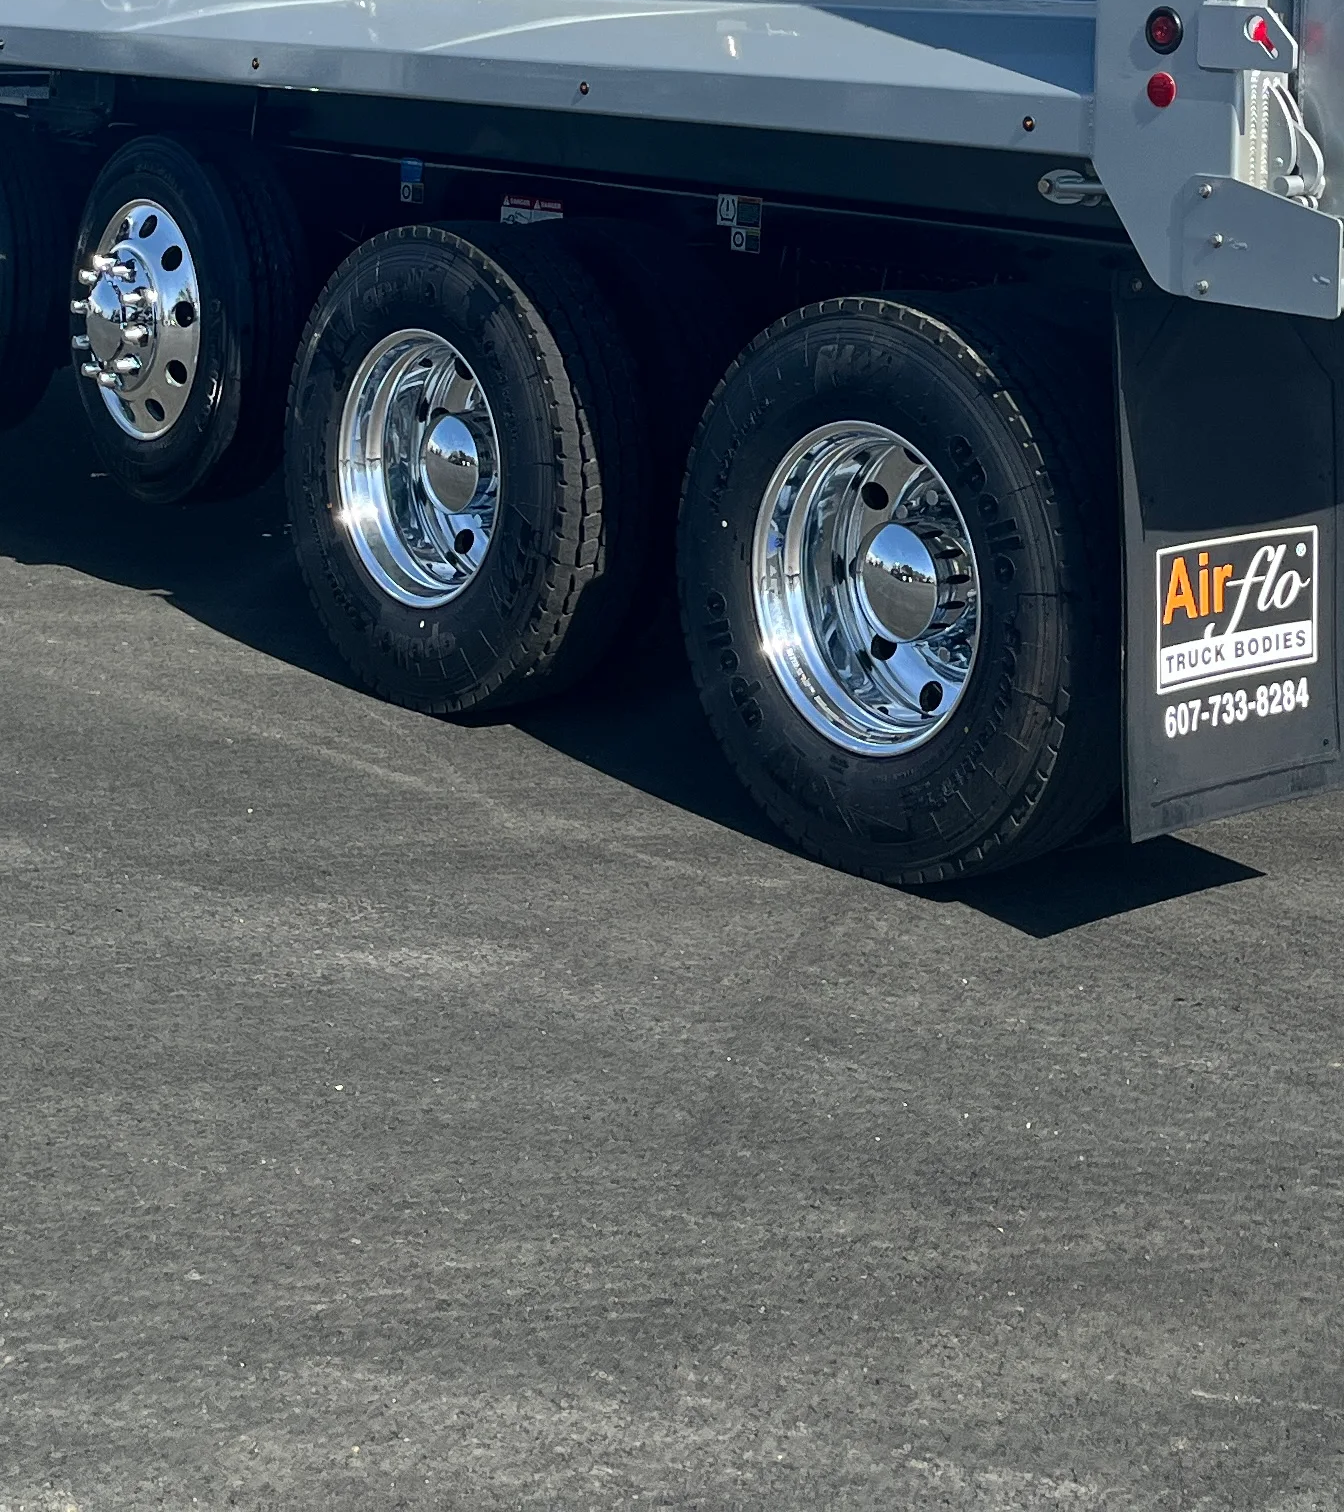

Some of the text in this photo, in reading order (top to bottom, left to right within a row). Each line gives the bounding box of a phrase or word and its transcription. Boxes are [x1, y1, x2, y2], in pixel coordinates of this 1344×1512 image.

[1165, 629, 1307, 674] TRUCK BODIES
[1164, 676, 1311, 739] 607-733-8284
